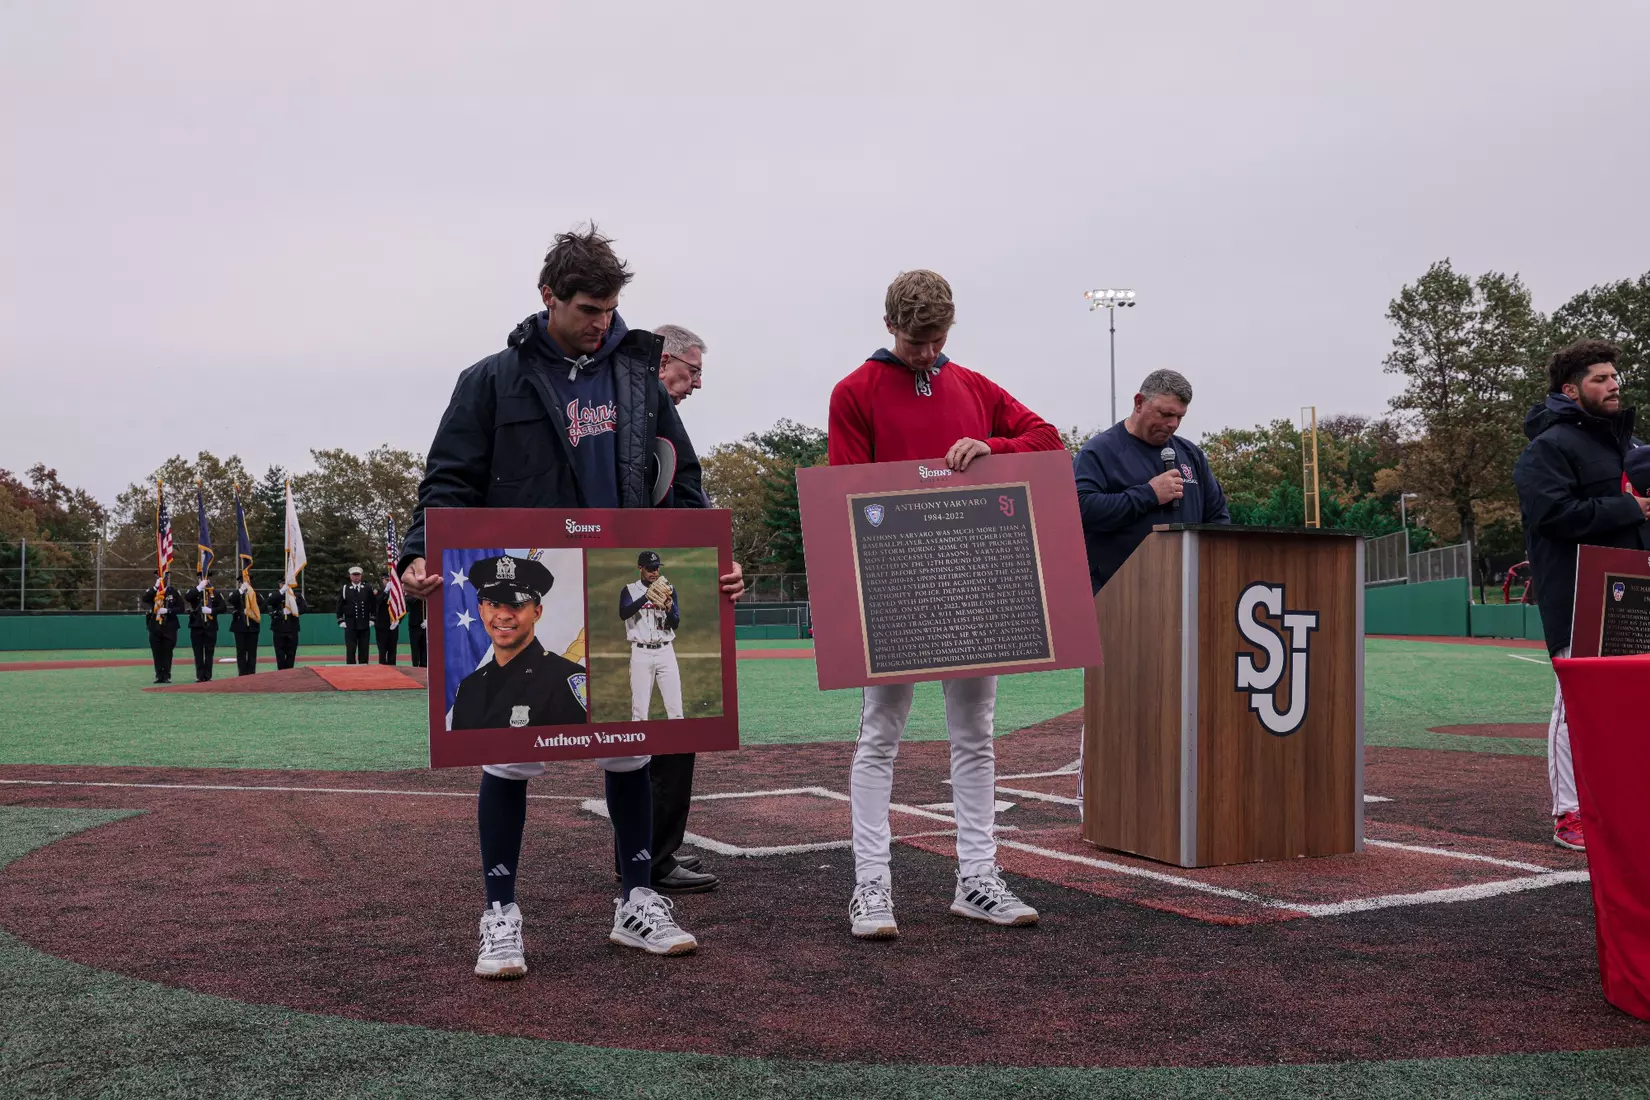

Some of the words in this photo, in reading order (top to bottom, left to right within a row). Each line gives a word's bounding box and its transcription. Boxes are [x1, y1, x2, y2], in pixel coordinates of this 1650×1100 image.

[893, 500, 942, 512] ANTHONY
[943, 497, 987, 508] VARVARO
[922, 511, 965, 522] 1984-2022
[862, 541, 896, 549] BASEBALL
[929, 535, 968, 544] STANDOUT
[968, 533, 998, 541] PITCHER
[899, 531, 933, 539] VARVARO
[879, 547, 905, 555] STORM
[907, 545, 936, 553] DURING
[988, 538, 1028, 546] PROGRAM'S
[888, 553, 933, 561] SUCCESSFUL
[937, 550, 972, 558] SEASONS,
[974, 547, 1011, 555] VARVARO
[918, 566, 953, 574] SPENDING
[938, 572, 971, 580] RETIRING
[867, 584, 902, 592] VARVARO
[902, 582, 935, 590] ENTERED
[952, 578, 987, 586] ACADEMY
[868, 591, 911, 600] AUTHORITY
[995, 582, 1022, 590] WHERE
[918, 594, 964, 603] DISTINCTION
[870, 613, 916, 622] PARTICIPATE
[955, 607, 993, 615] MEMORIAL
[871, 621, 906, 630] VARVARO
[908, 618, 951, 627] TRAGICALLY
[1017, 610, 1039, 618] HEAD-
[884, 627, 922, 636] COLLISION
[948, 622, 994, 631] WRONG-WAY
[994, 619, 1020, 627] DRIVER
[890, 635, 924, 643] HOLLAND
[927, 632, 957, 640] TUNNEL.
[1000, 625, 1041, 634] ANTHONY'S
[930, 646, 976, 655] COMMUNITY
[1017, 640, 1044, 648] JOHN'S
[875, 659, 911, 667] PROGRAM
[932, 654, 966, 663] PROUDLY
[966, 652, 996, 660] HONORS
[1011, 648, 1041, 656] LEGACY.
[533, 733, 593, 748] Anthony
[594, 732, 646, 744] Varvaro
